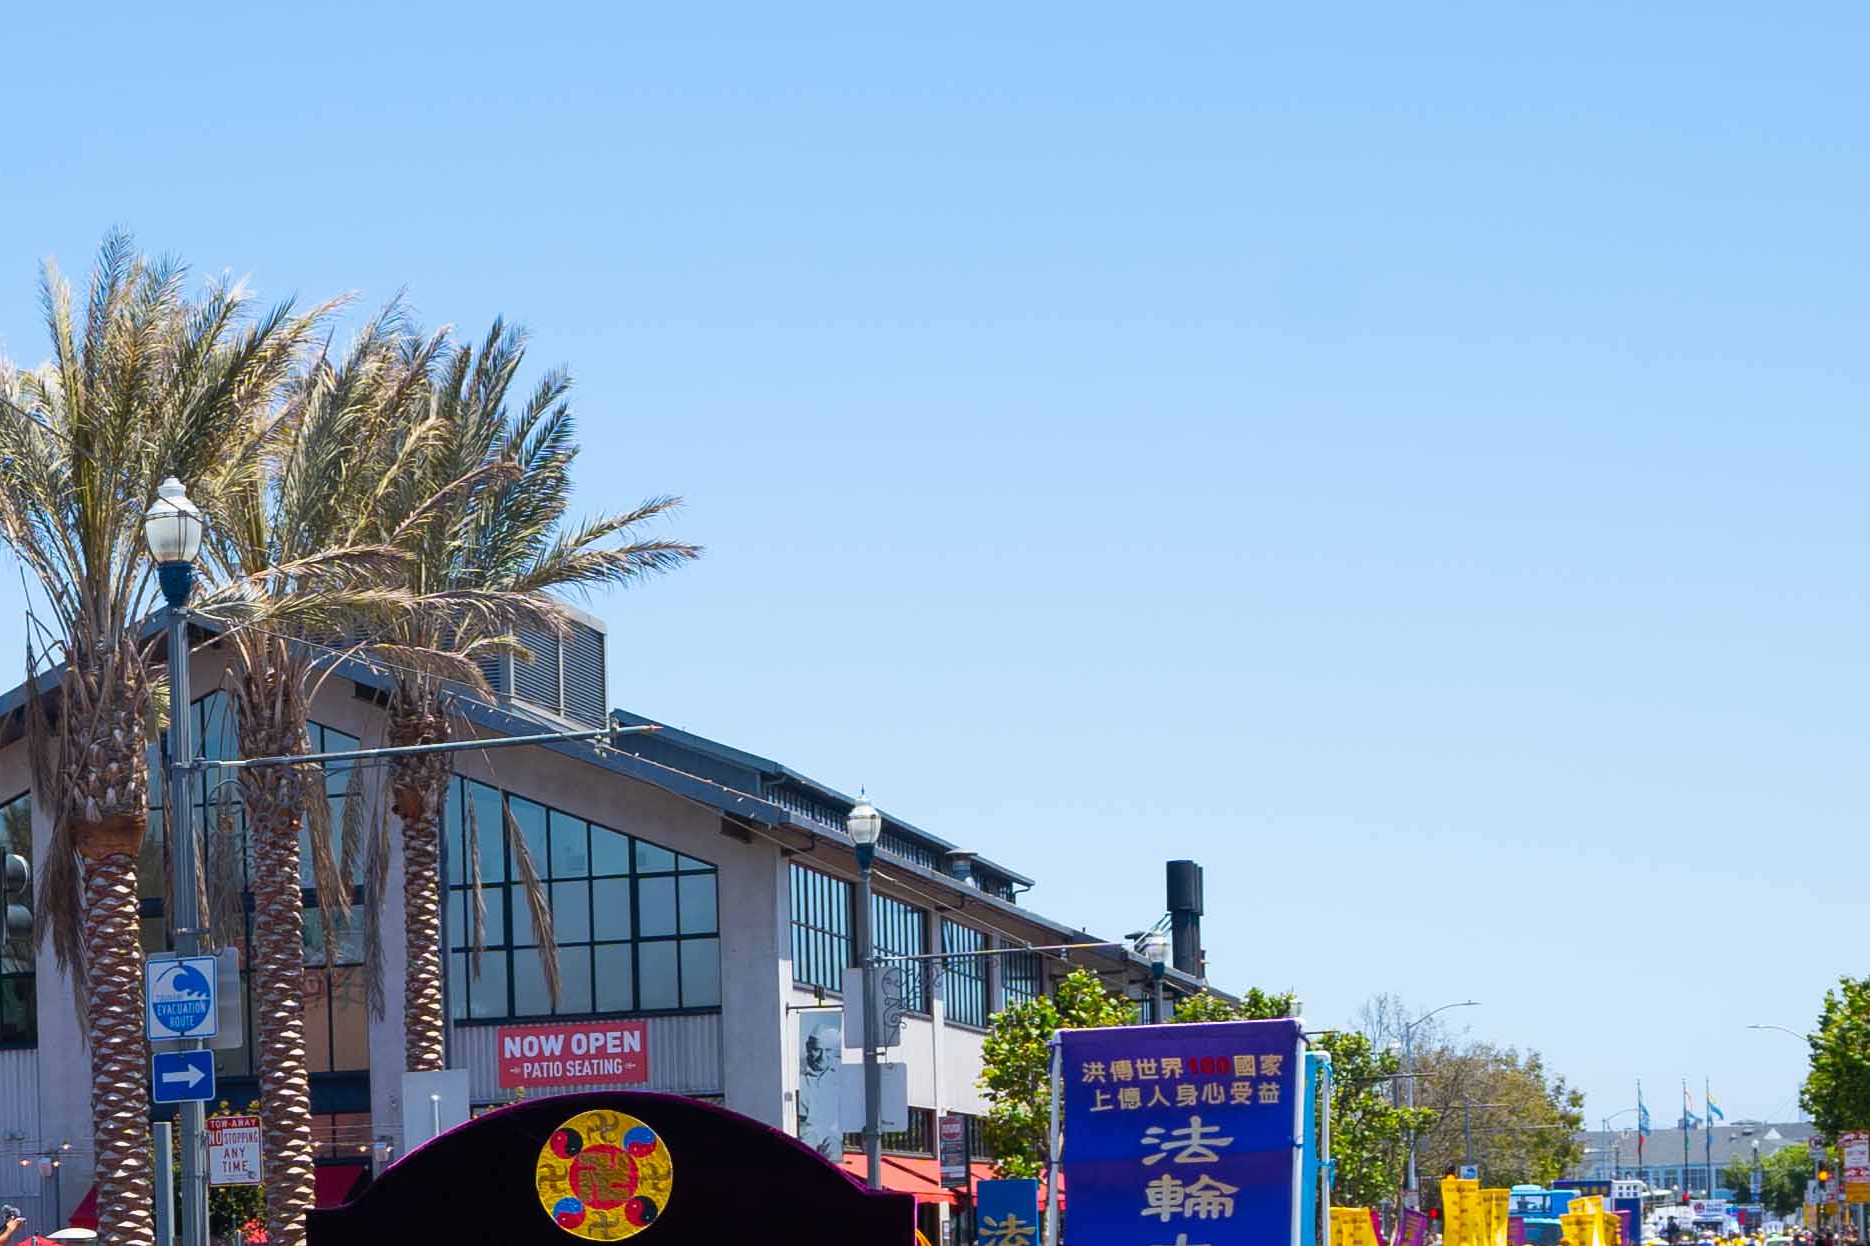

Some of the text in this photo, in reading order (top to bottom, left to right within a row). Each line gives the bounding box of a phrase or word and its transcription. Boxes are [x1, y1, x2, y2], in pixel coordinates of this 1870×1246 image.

[157, 1001, 206, 1016] EVACUATION
[170, 1015, 194, 1027] ROUTE
[504, 1030, 641, 1058] NOW OPEN
[523, 1058, 623, 1079] PATIO SEATING
[210, 1130, 222, 1145] NO
[224, 1147, 246, 1159] ANY
[222, 1161, 249, 1173] TIME
